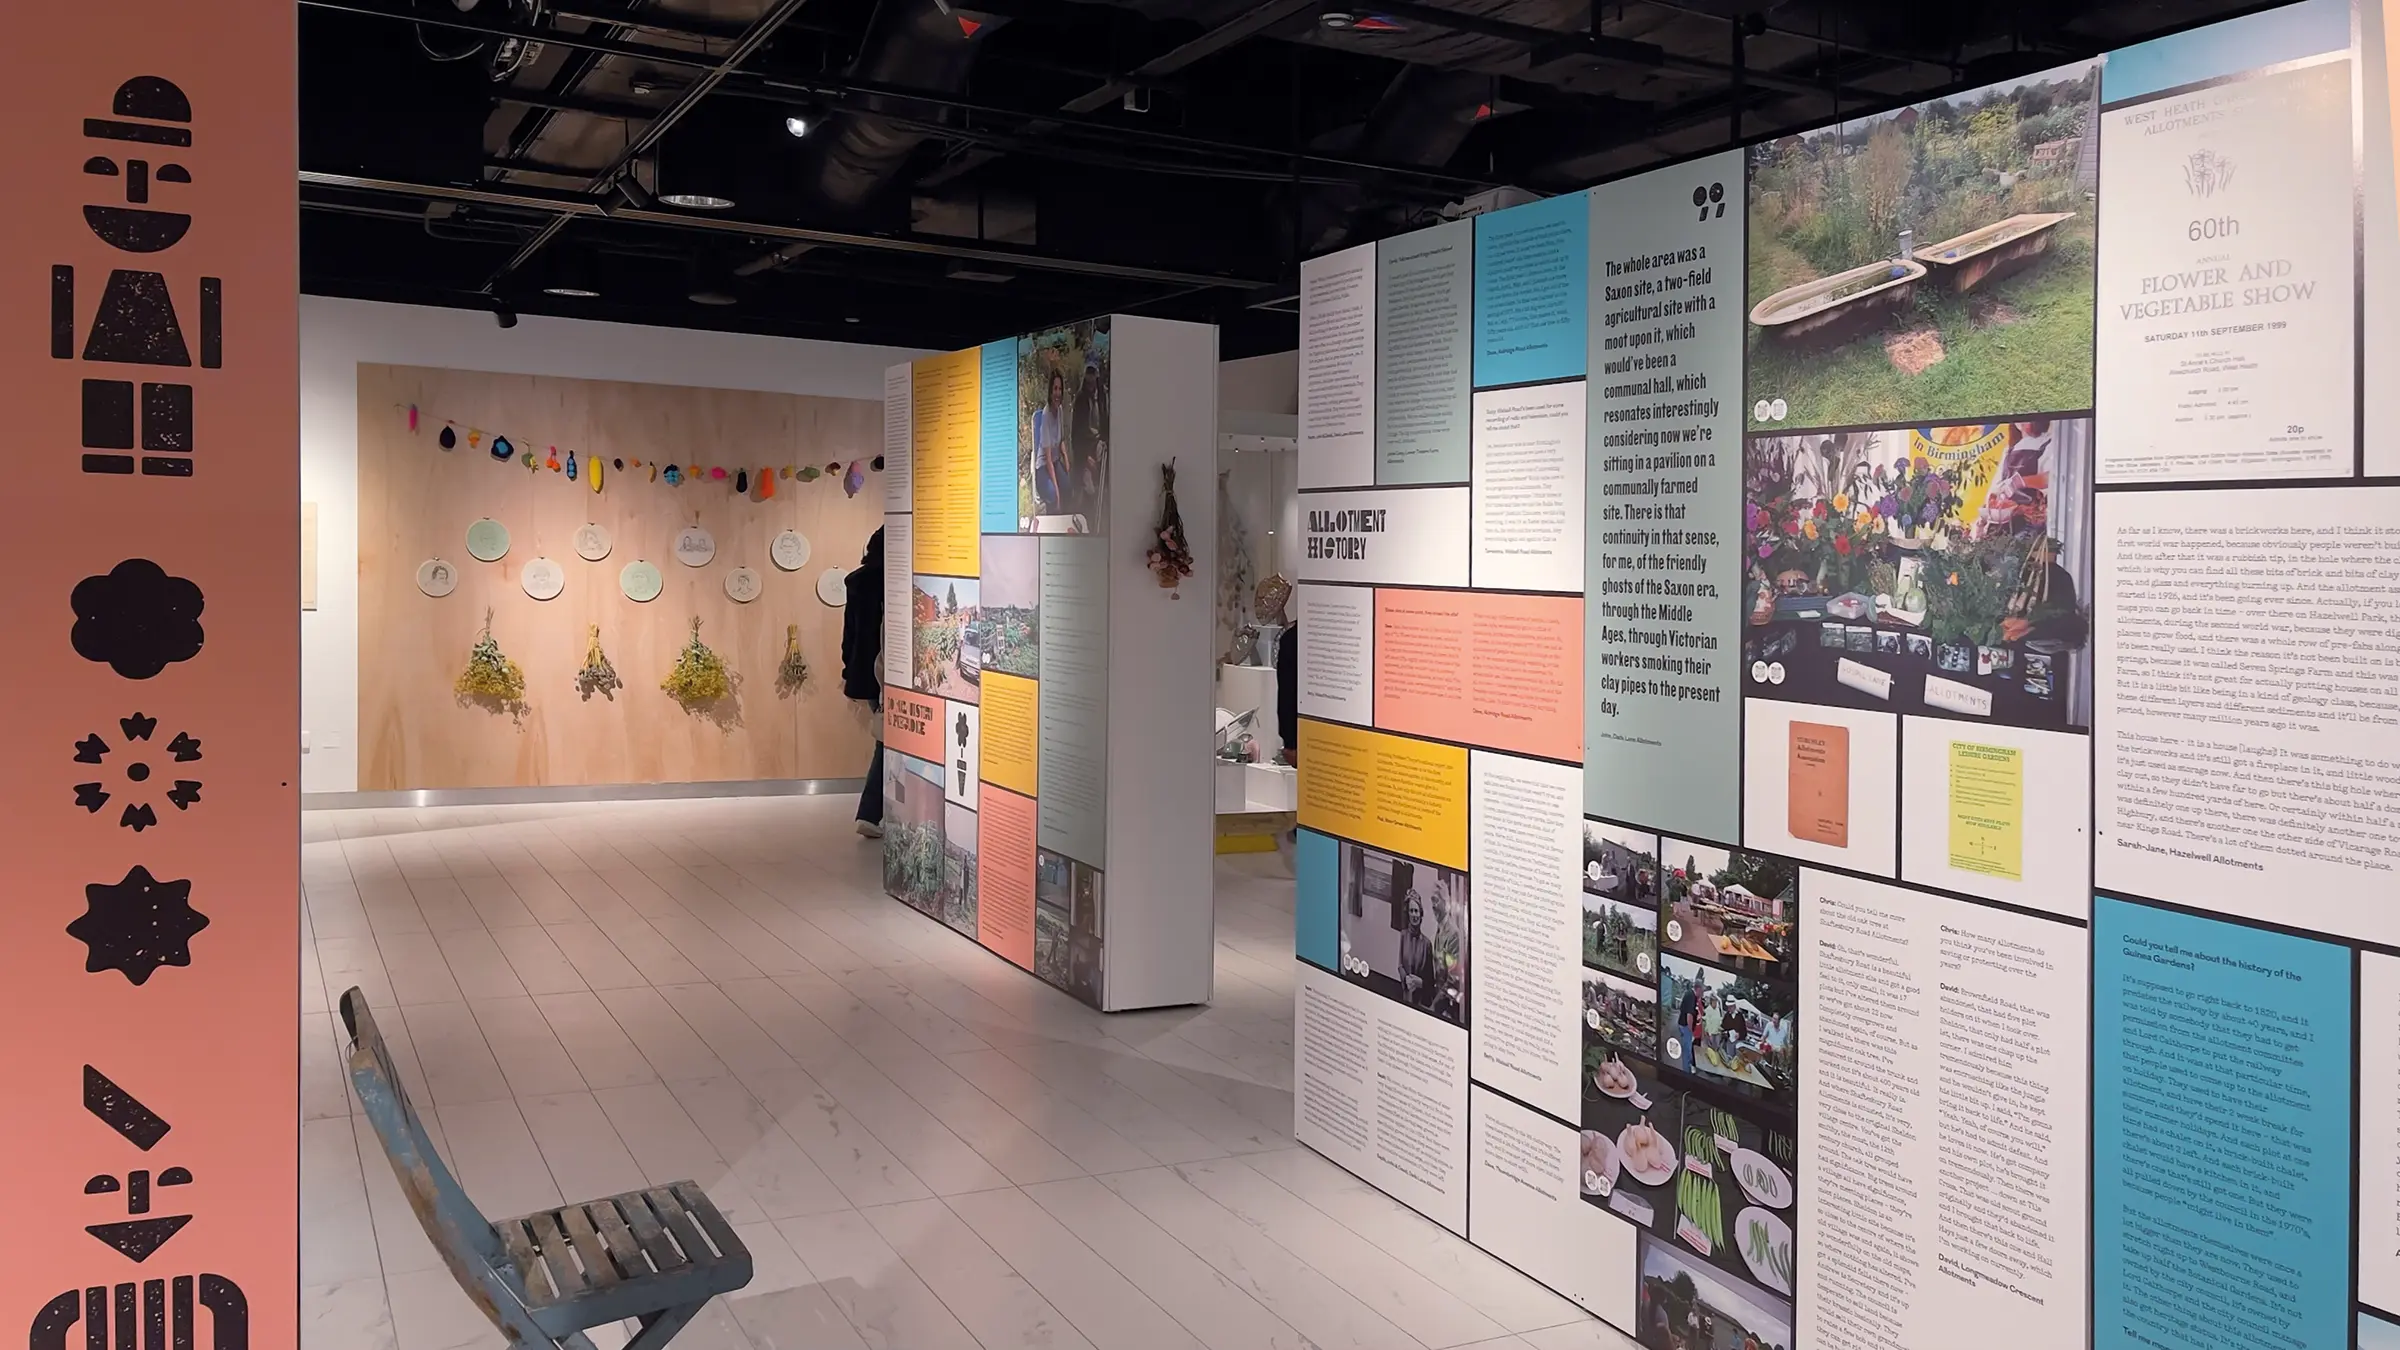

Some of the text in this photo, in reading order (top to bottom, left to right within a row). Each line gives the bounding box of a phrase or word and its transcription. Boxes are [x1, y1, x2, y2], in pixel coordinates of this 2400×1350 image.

[2124, 101, 2206, 126] WEST HEATH
[2144, 110, 2225, 136] ALLOTMENTS
[2189, 216, 2239, 241] 60th
[1605, 246, 1705, 276] The whole area was a
[2196, 254, 2231, 264] ANNUAL
[1605, 267, 1710, 301] Saxon site, a two-field
[2141, 259, 2291, 294] FLOWER AND
[1605, 294, 1715, 327] agricultural site with a
[2120, 281, 2317, 320] VEGETABLE SHOW
[1605, 322, 1694, 349] moot upon it, which
[2145, 321, 2286, 342] SATURDAY 11th SEPTEMBER 1999
[1604, 353, 1676, 374] would've been a
[1604, 373, 1706, 398] communal hall, which
[1604, 398, 1718, 422] resonates interestingly
[1604, 424, 1711, 447] considering now we're
[2287, 425, 2304, 434] 20p
[1914, 432, 2004, 460] in Birmingham
[1603, 452, 1715, 473] sitting in a pavilion on a
[1603, 476, 1697, 497] communally farmed
[1307, 510, 1386, 532] ALLOTMENT
[1603, 503, 1685, 520] site. There is that
[1308, 538, 1366, 560] HISTORY
[1602, 528, 1718, 547] continuity in that sense,
[1602, 553, 1706, 574] for me, of the friendly
[1602, 577, 1718, 599] ghosts of the Saxon era,
[1602, 601, 1692, 621] through the Middle
[1601, 625, 1716, 649] Ages, through Victorian
[1601, 651, 1711, 675] workers smoking their
[1601, 674, 1720, 702] clay pipes to the present
[1929, 686, 1987, 710] ALLOTMENTS
[1601, 697, 1619, 717] day.
[1976, 746, 2016, 756] BIRMINGHAM
[2117, 838, 2263, 870] Sarah-Jane, Hazelwell Allotments
[1940, 924, 1959, 935] Chris:
[2122, 947, 2194, 970] Guinea Gardens?
[2123, 934, 2301, 981] Could you tell me about the history of the
[1938, 1265, 1975, 1286] Allotments
[1938, 1253, 2043, 1305] David, Longmeadow Crescent
[2123, 1326, 2150, 1344] Tell me
